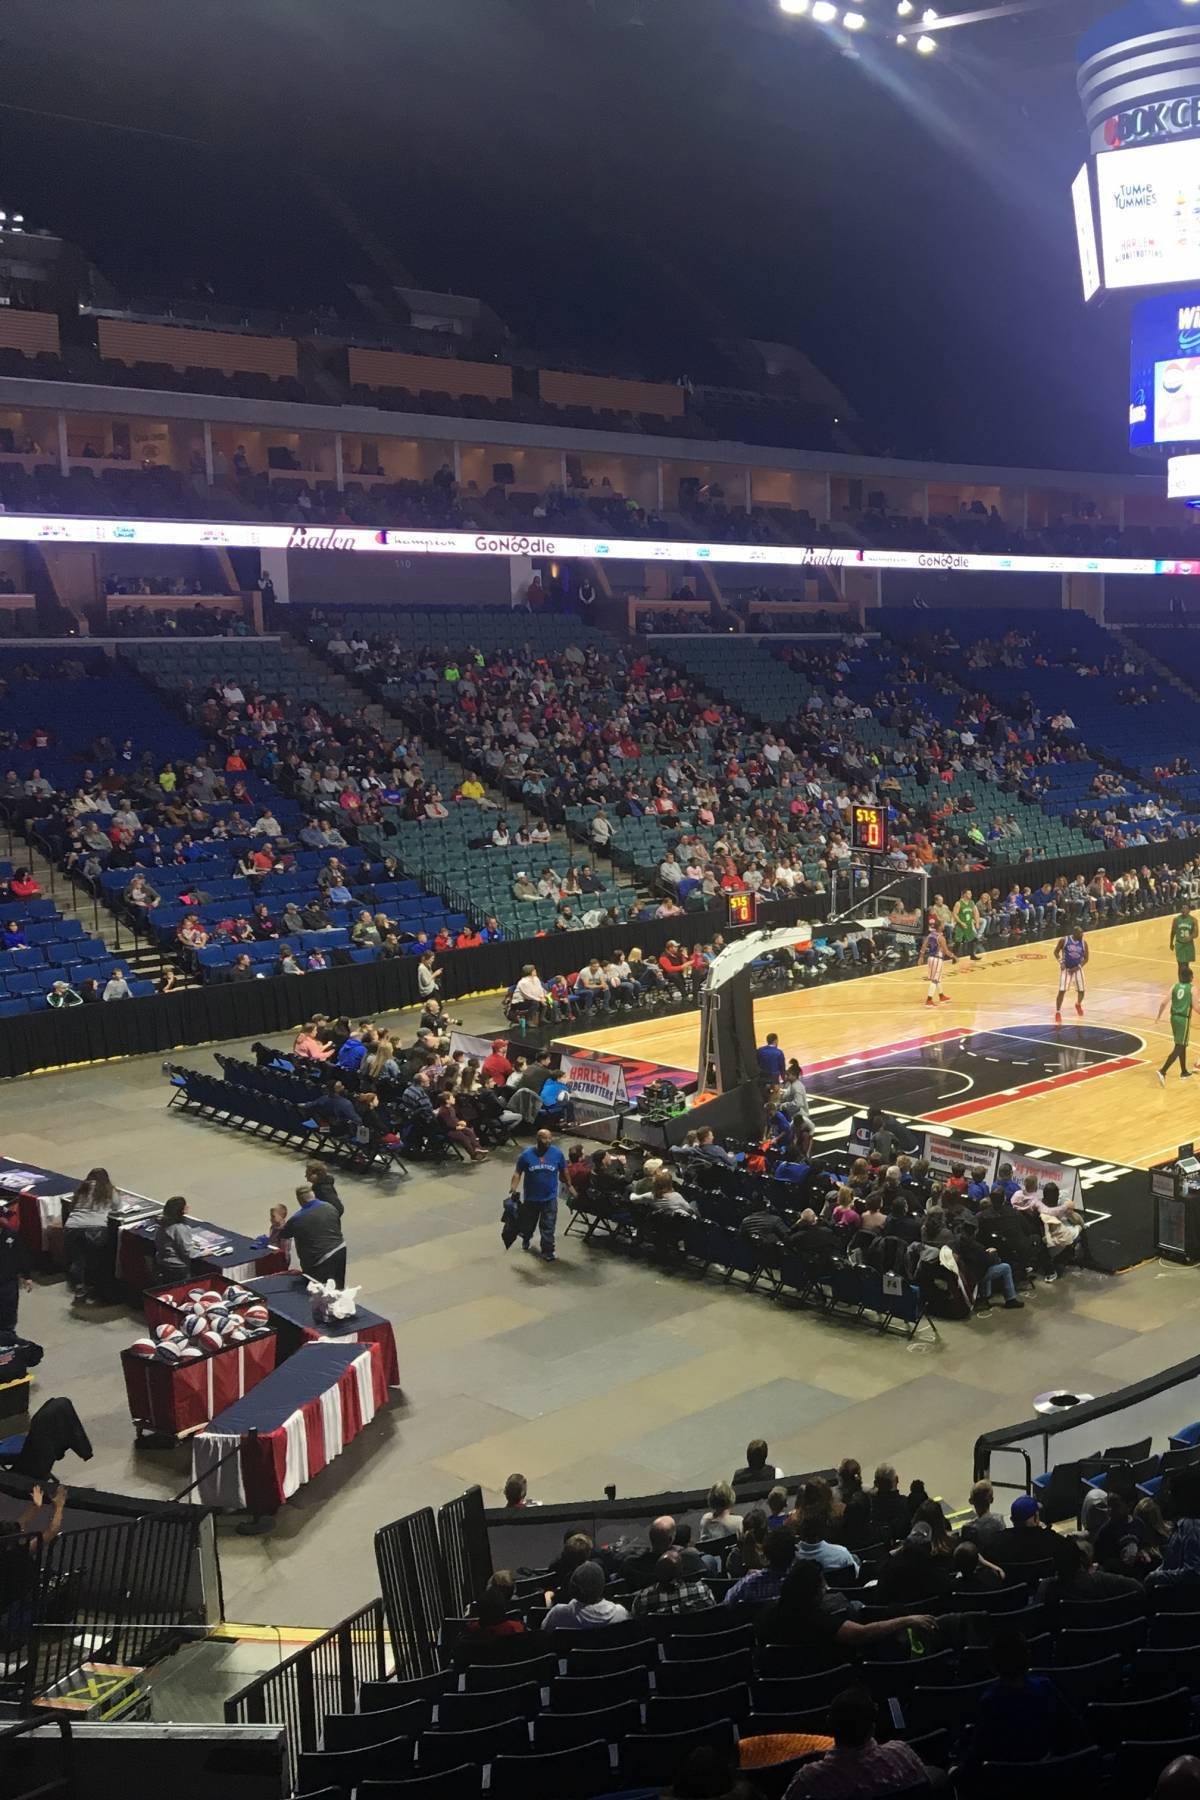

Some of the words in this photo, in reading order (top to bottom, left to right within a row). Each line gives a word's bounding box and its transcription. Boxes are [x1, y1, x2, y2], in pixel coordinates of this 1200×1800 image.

[1116, 104, 1168, 142] BOK
[1112, 193, 1158, 210] YUMMIES
[286, 527, 356, 551] Baden
[867, 823, 880, 846] 0
[739, 907, 749, 921] 0
[1176, 988, 1185, 1000] 0
[569, 1066, 611, 1088] HARLEM
